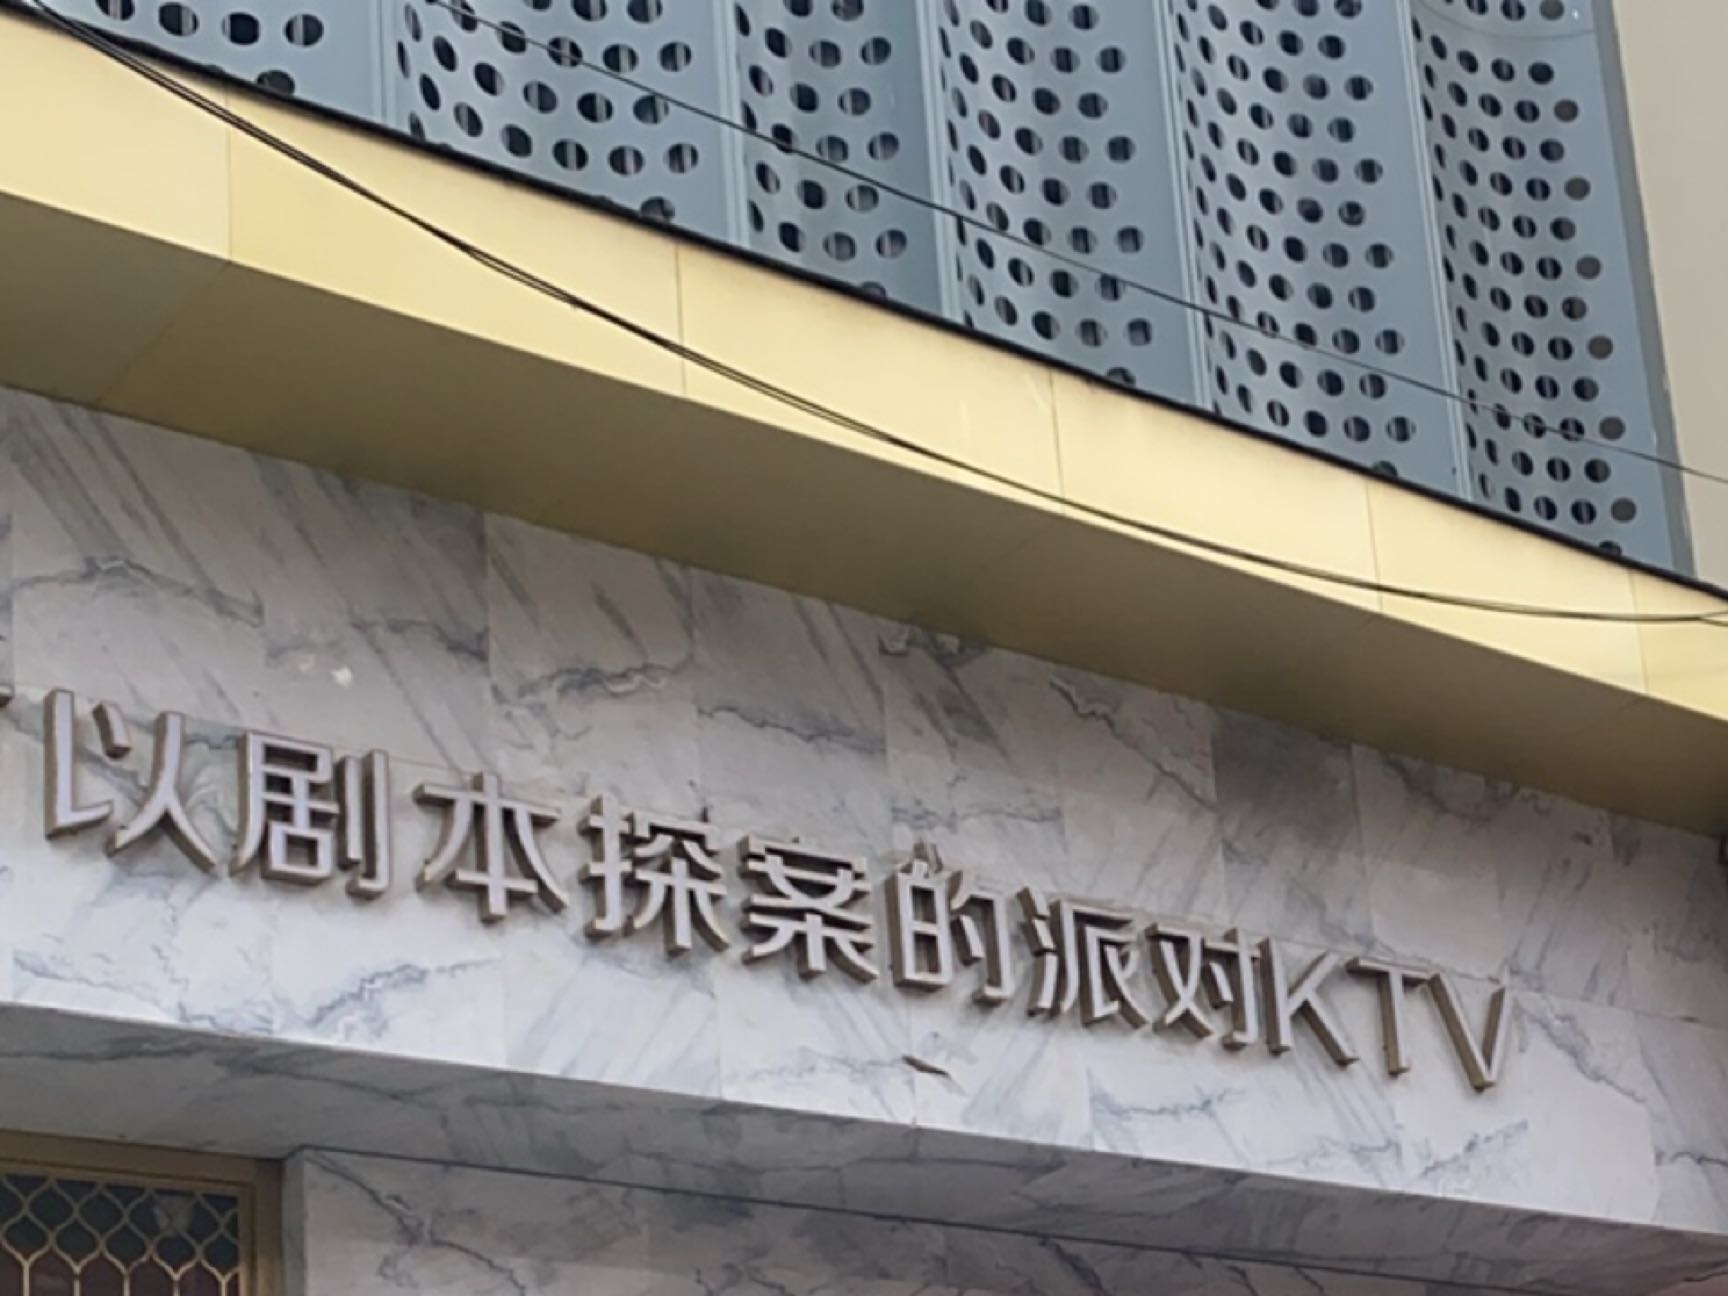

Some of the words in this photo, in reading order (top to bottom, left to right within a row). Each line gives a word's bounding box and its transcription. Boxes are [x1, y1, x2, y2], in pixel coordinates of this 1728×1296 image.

[0, 684, 1510, 1092] 以剧本探案的派对KTV
